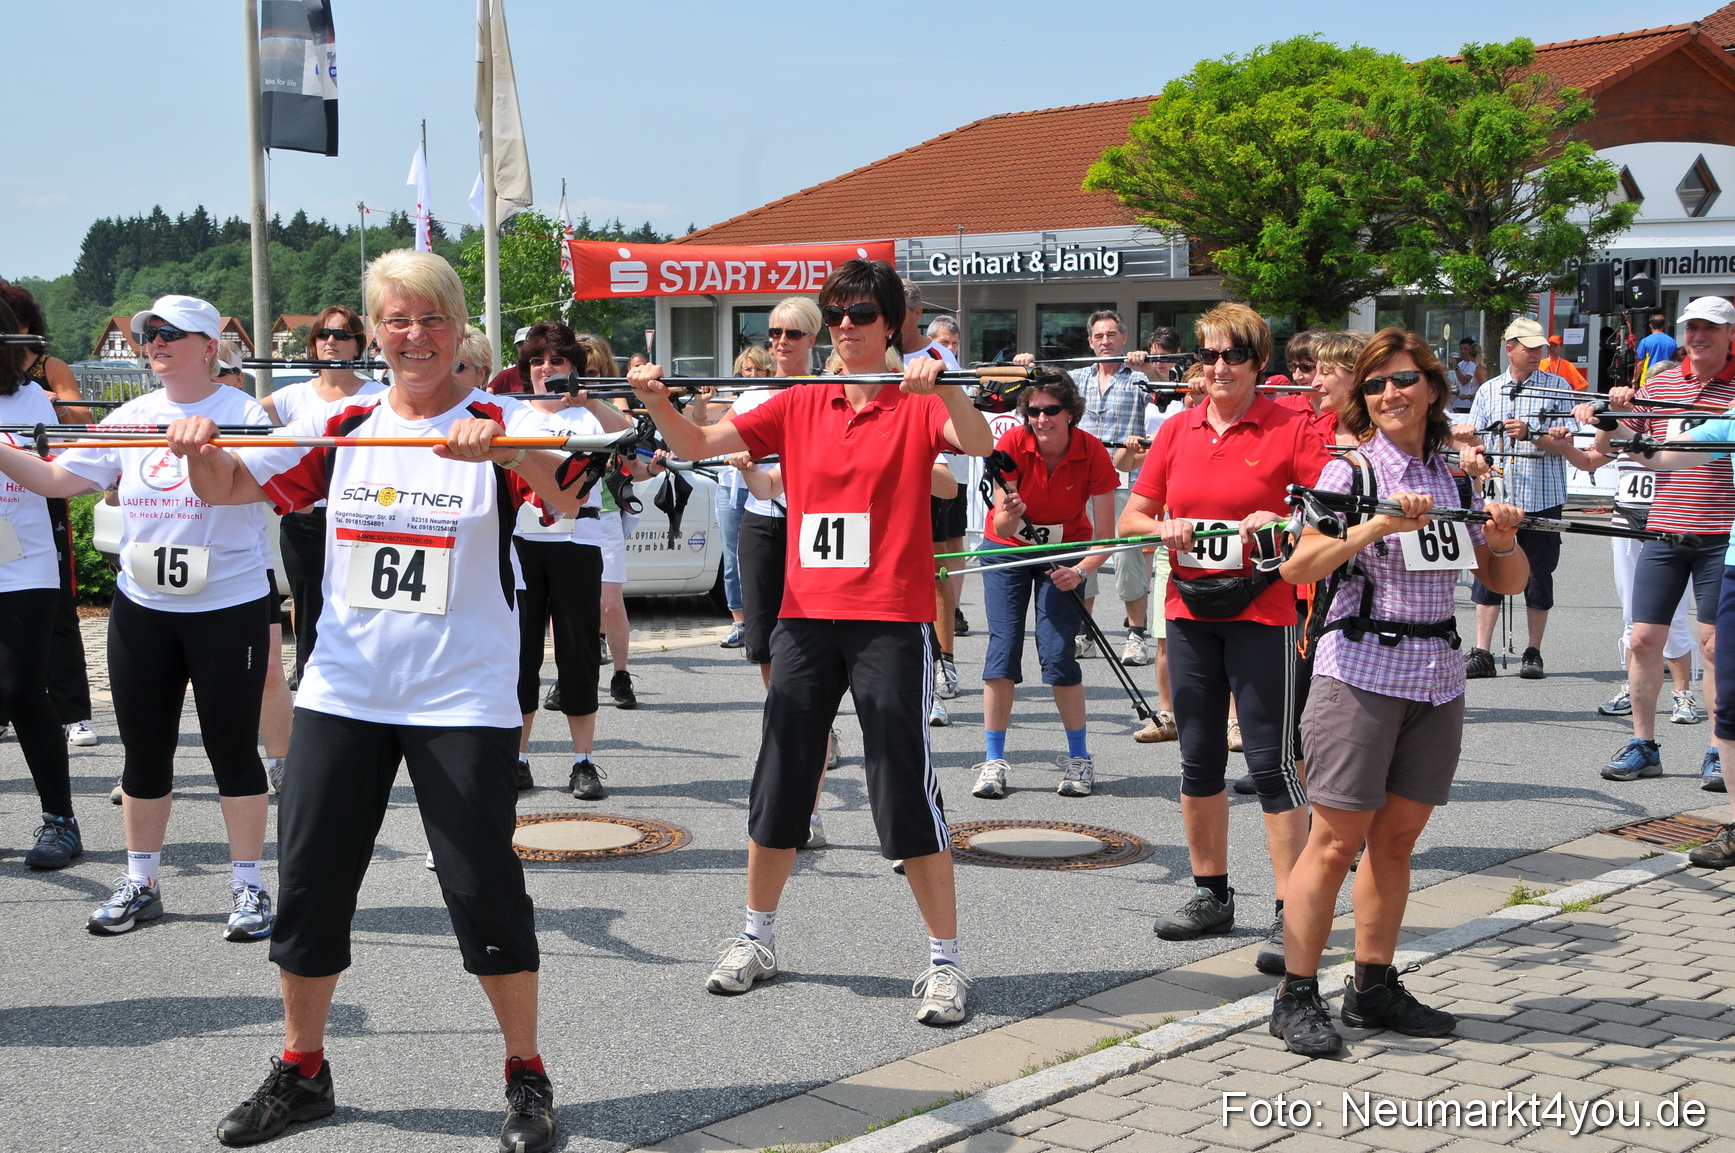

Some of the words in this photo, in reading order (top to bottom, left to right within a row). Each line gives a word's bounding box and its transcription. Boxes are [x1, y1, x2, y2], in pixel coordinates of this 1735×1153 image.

[929, 251, 1022, 276] Gerhart
[1029, 250, 1045, 273] &
[1053, 244, 1119, 276] Jänig
[1627, 475, 1653, 499] 46
[122, 496, 157, 507] LAUFEN
[162, 498, 180, 507] MIT
[129, 511, 139, 519] Dr.
[140, 511, 158, 519] Heck
[177, 512, 203, 520] Röschl
[335, 510, 376, 520] Regensburger
[429, 518, 459, 526] Neumarkt
[635, 530, 683, 540] 09181/470
[812, 517, 845, 561] 41
[1018, 526, 1051, 545] 43
[1192, 521, 1229, 562] 40
[1417, 519, 1460, 563] 69
[153, 546, 188, 588] 15
[371, 546, 426, 602] 64
